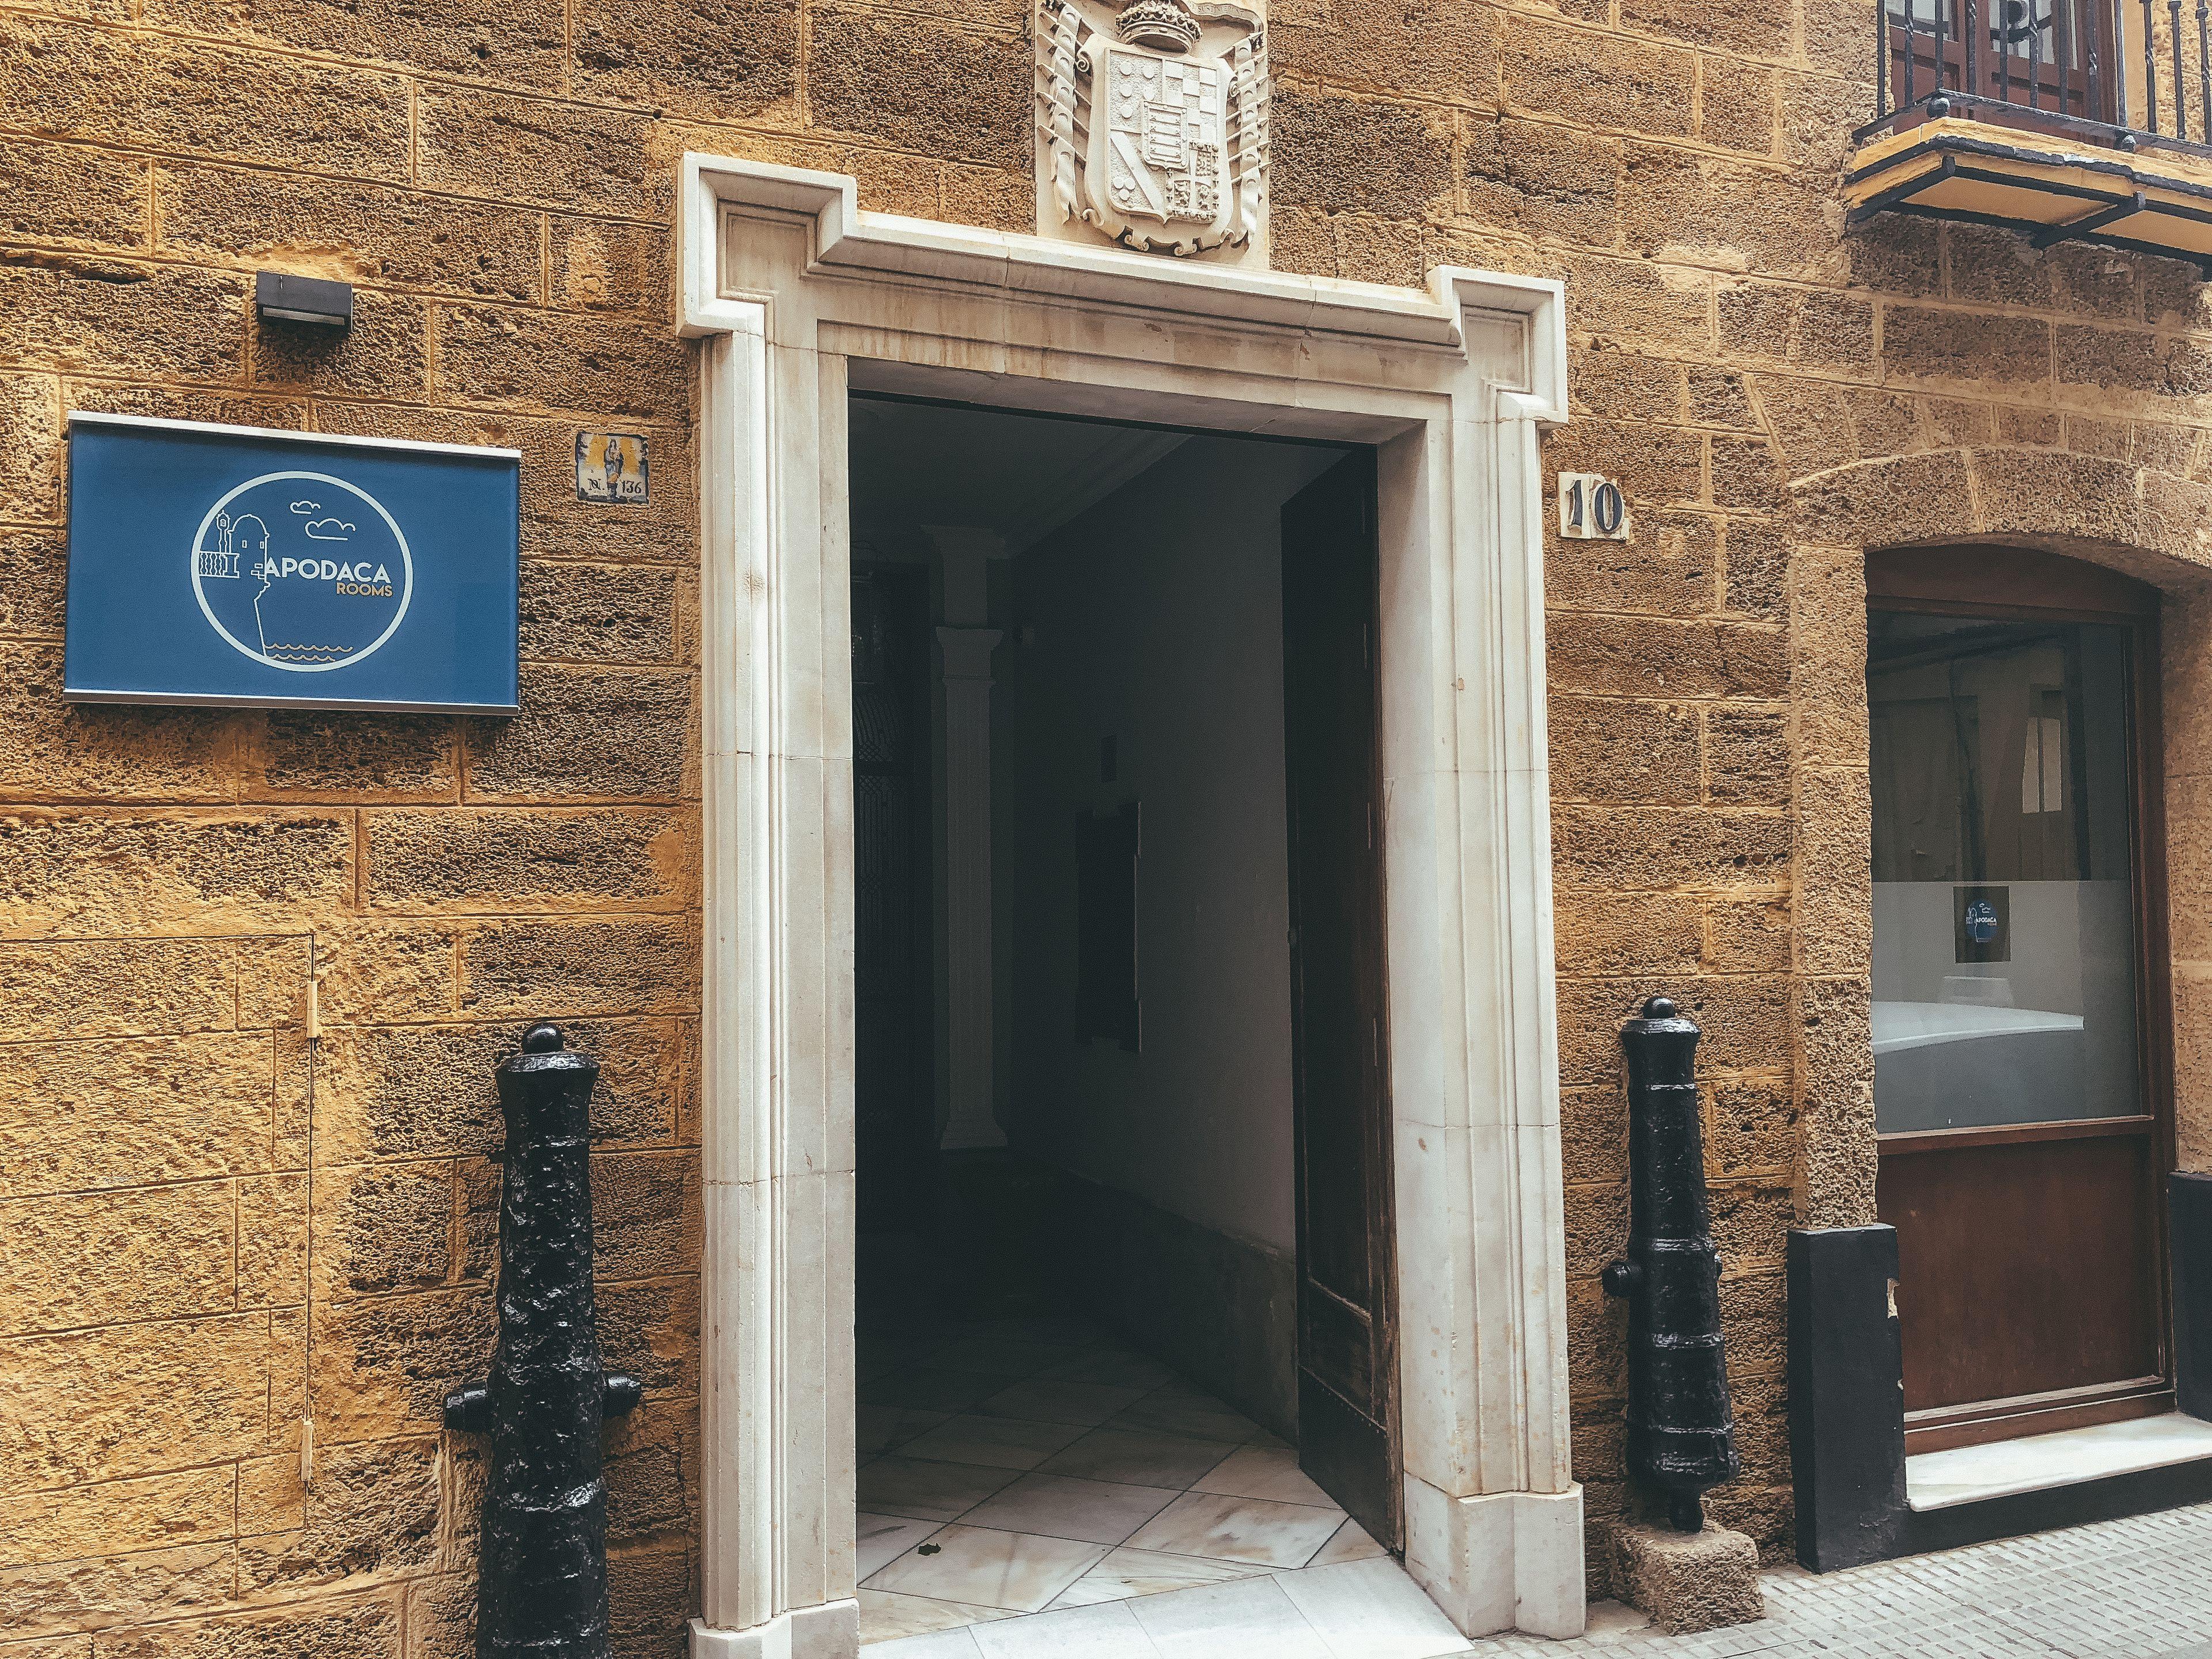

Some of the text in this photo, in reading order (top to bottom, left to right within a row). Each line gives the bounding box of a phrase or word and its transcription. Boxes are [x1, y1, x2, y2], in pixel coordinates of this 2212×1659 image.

[621, 480, 642, 494] 136
[1565, 479, 1623, 535] 10
[266, 556, 392, 584] APODACA
[336, 582, 393, 597] ROOMS
